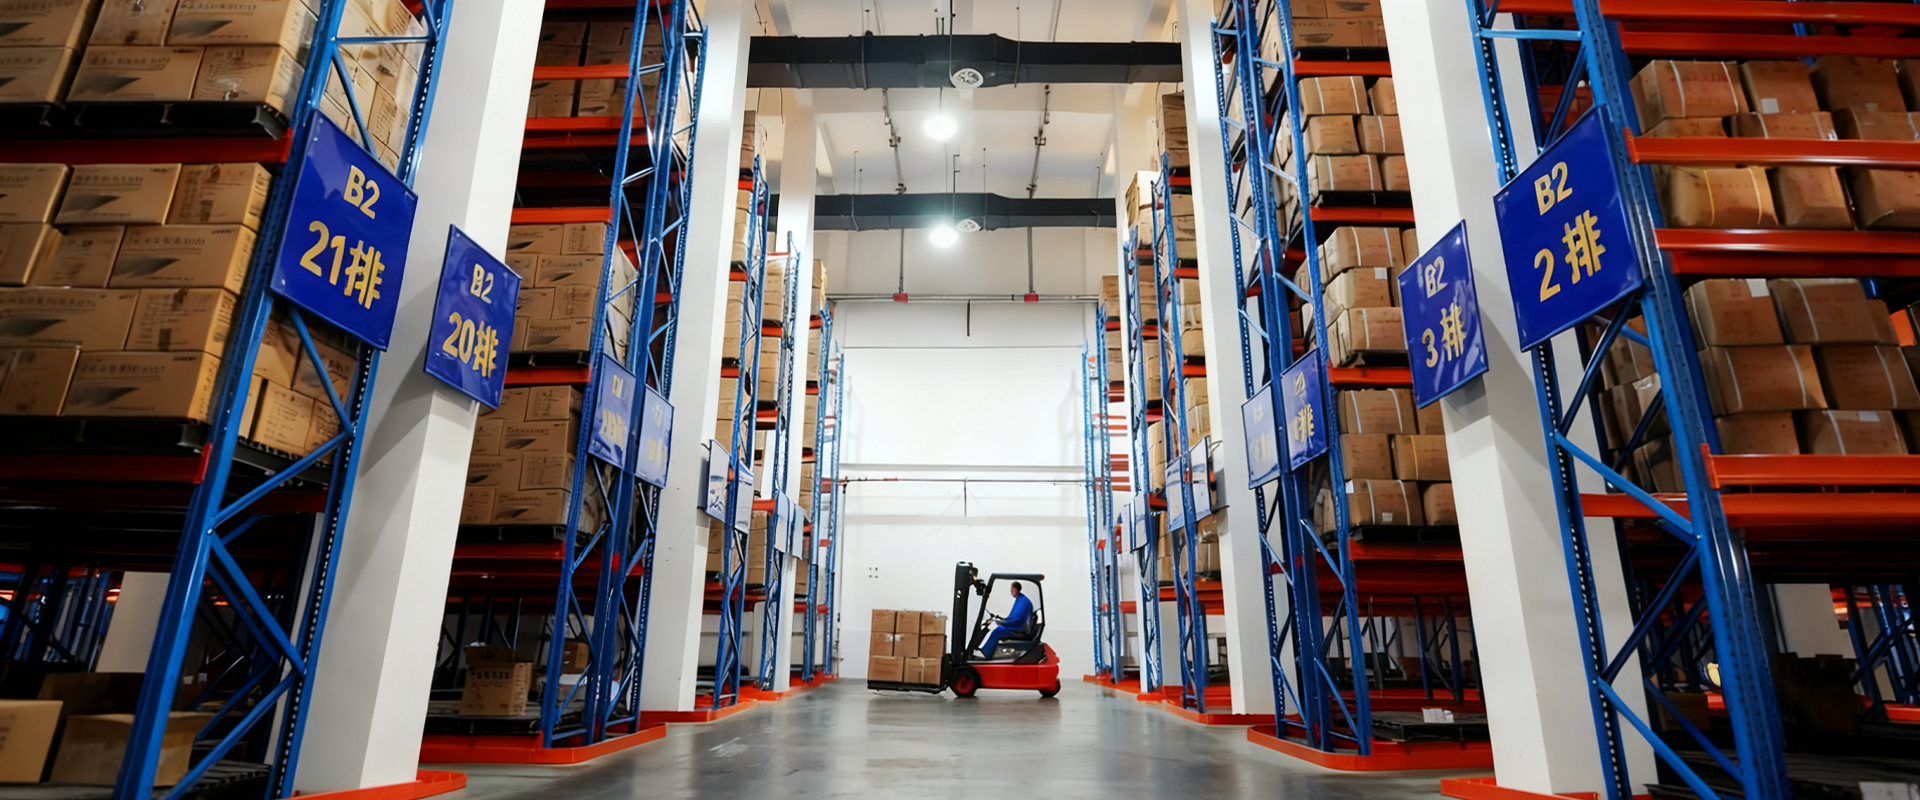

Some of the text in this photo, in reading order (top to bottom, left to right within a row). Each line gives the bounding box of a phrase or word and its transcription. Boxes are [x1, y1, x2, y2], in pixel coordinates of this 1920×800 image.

[343, 165, 380, 219] B2
[1534, 161, 1573, 216] B2
[300, 220, 385, 309] 21排
[470, 263, 493, 304] B2
[1424, 256, 1448, 298] B2
[442, 312, 499, 378] 20排
